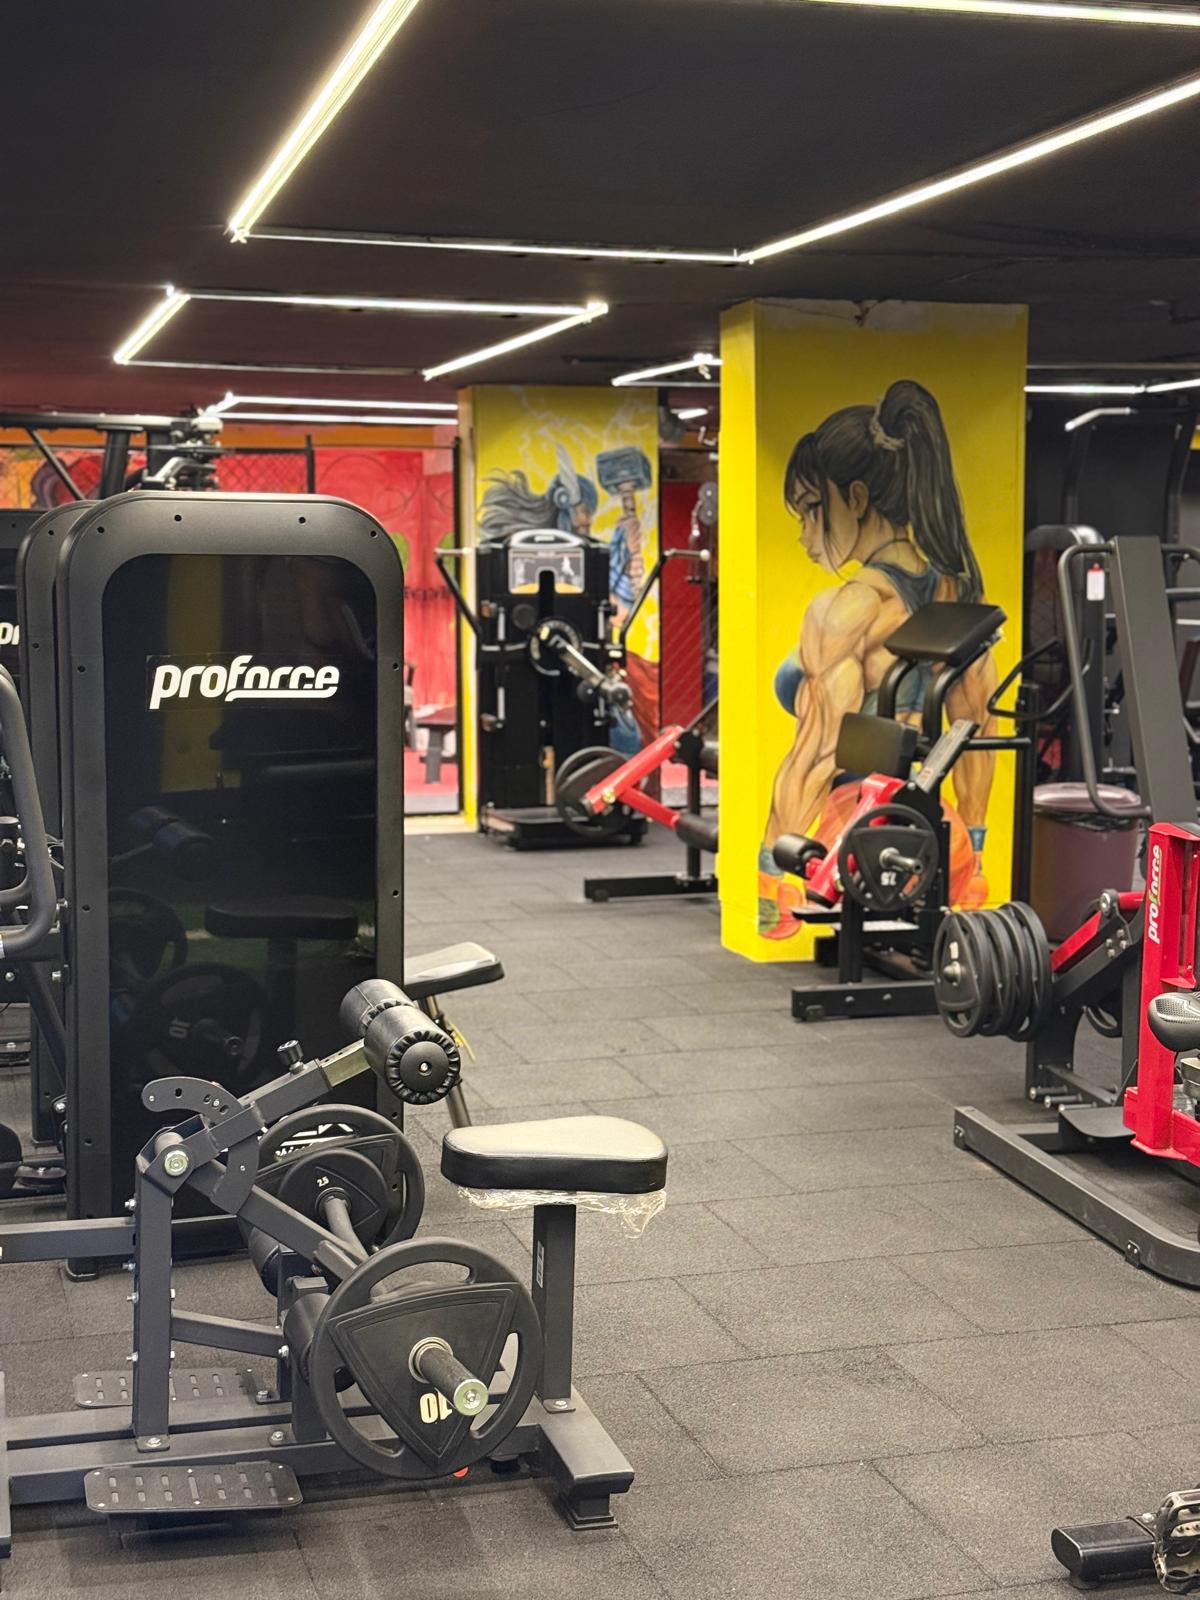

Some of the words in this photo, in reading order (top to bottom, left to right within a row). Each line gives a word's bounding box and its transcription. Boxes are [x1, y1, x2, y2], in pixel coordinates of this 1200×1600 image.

[149, 655, 340, 710] proforce
[1148, 844, 1163, 944] proforce
[419, 1391, 453, 1424] 10
